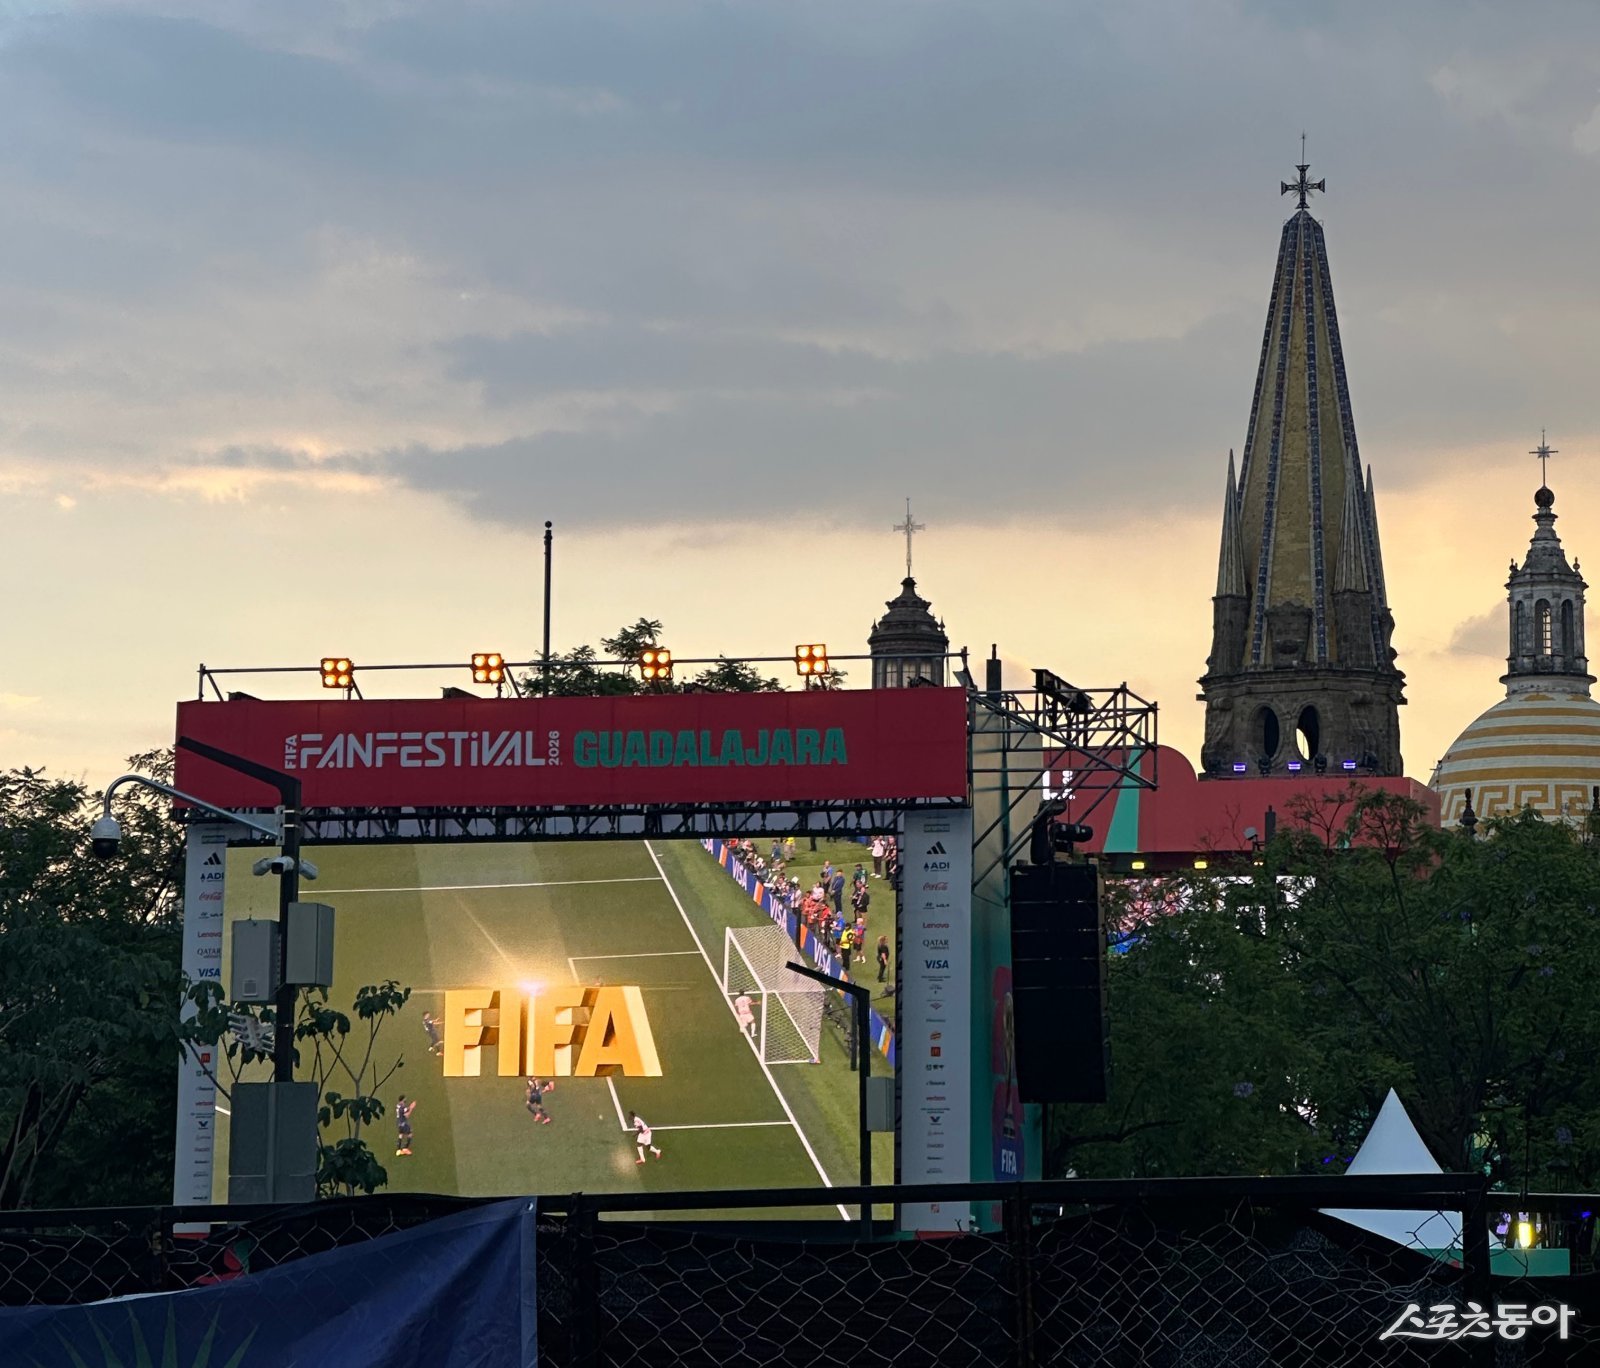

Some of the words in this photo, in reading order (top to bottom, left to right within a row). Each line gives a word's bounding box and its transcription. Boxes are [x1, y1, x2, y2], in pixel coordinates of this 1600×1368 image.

[284, 734, 298, 770] FIFA
[548, 730, 561, 766] 2026
[573, 727, 849, 768] GUADALAJARA
[769, 893, 788, 934] VISA
[812, 938, 832, 976] VISA
[922, 939, 949, 947] QATAR
[197, 967, 221, 978] VISA
[924, 959, 950, 969] VISA
[443, 985, 663, 1077] FIFA
[1001, 1148, 1017, 1175] FIFA
